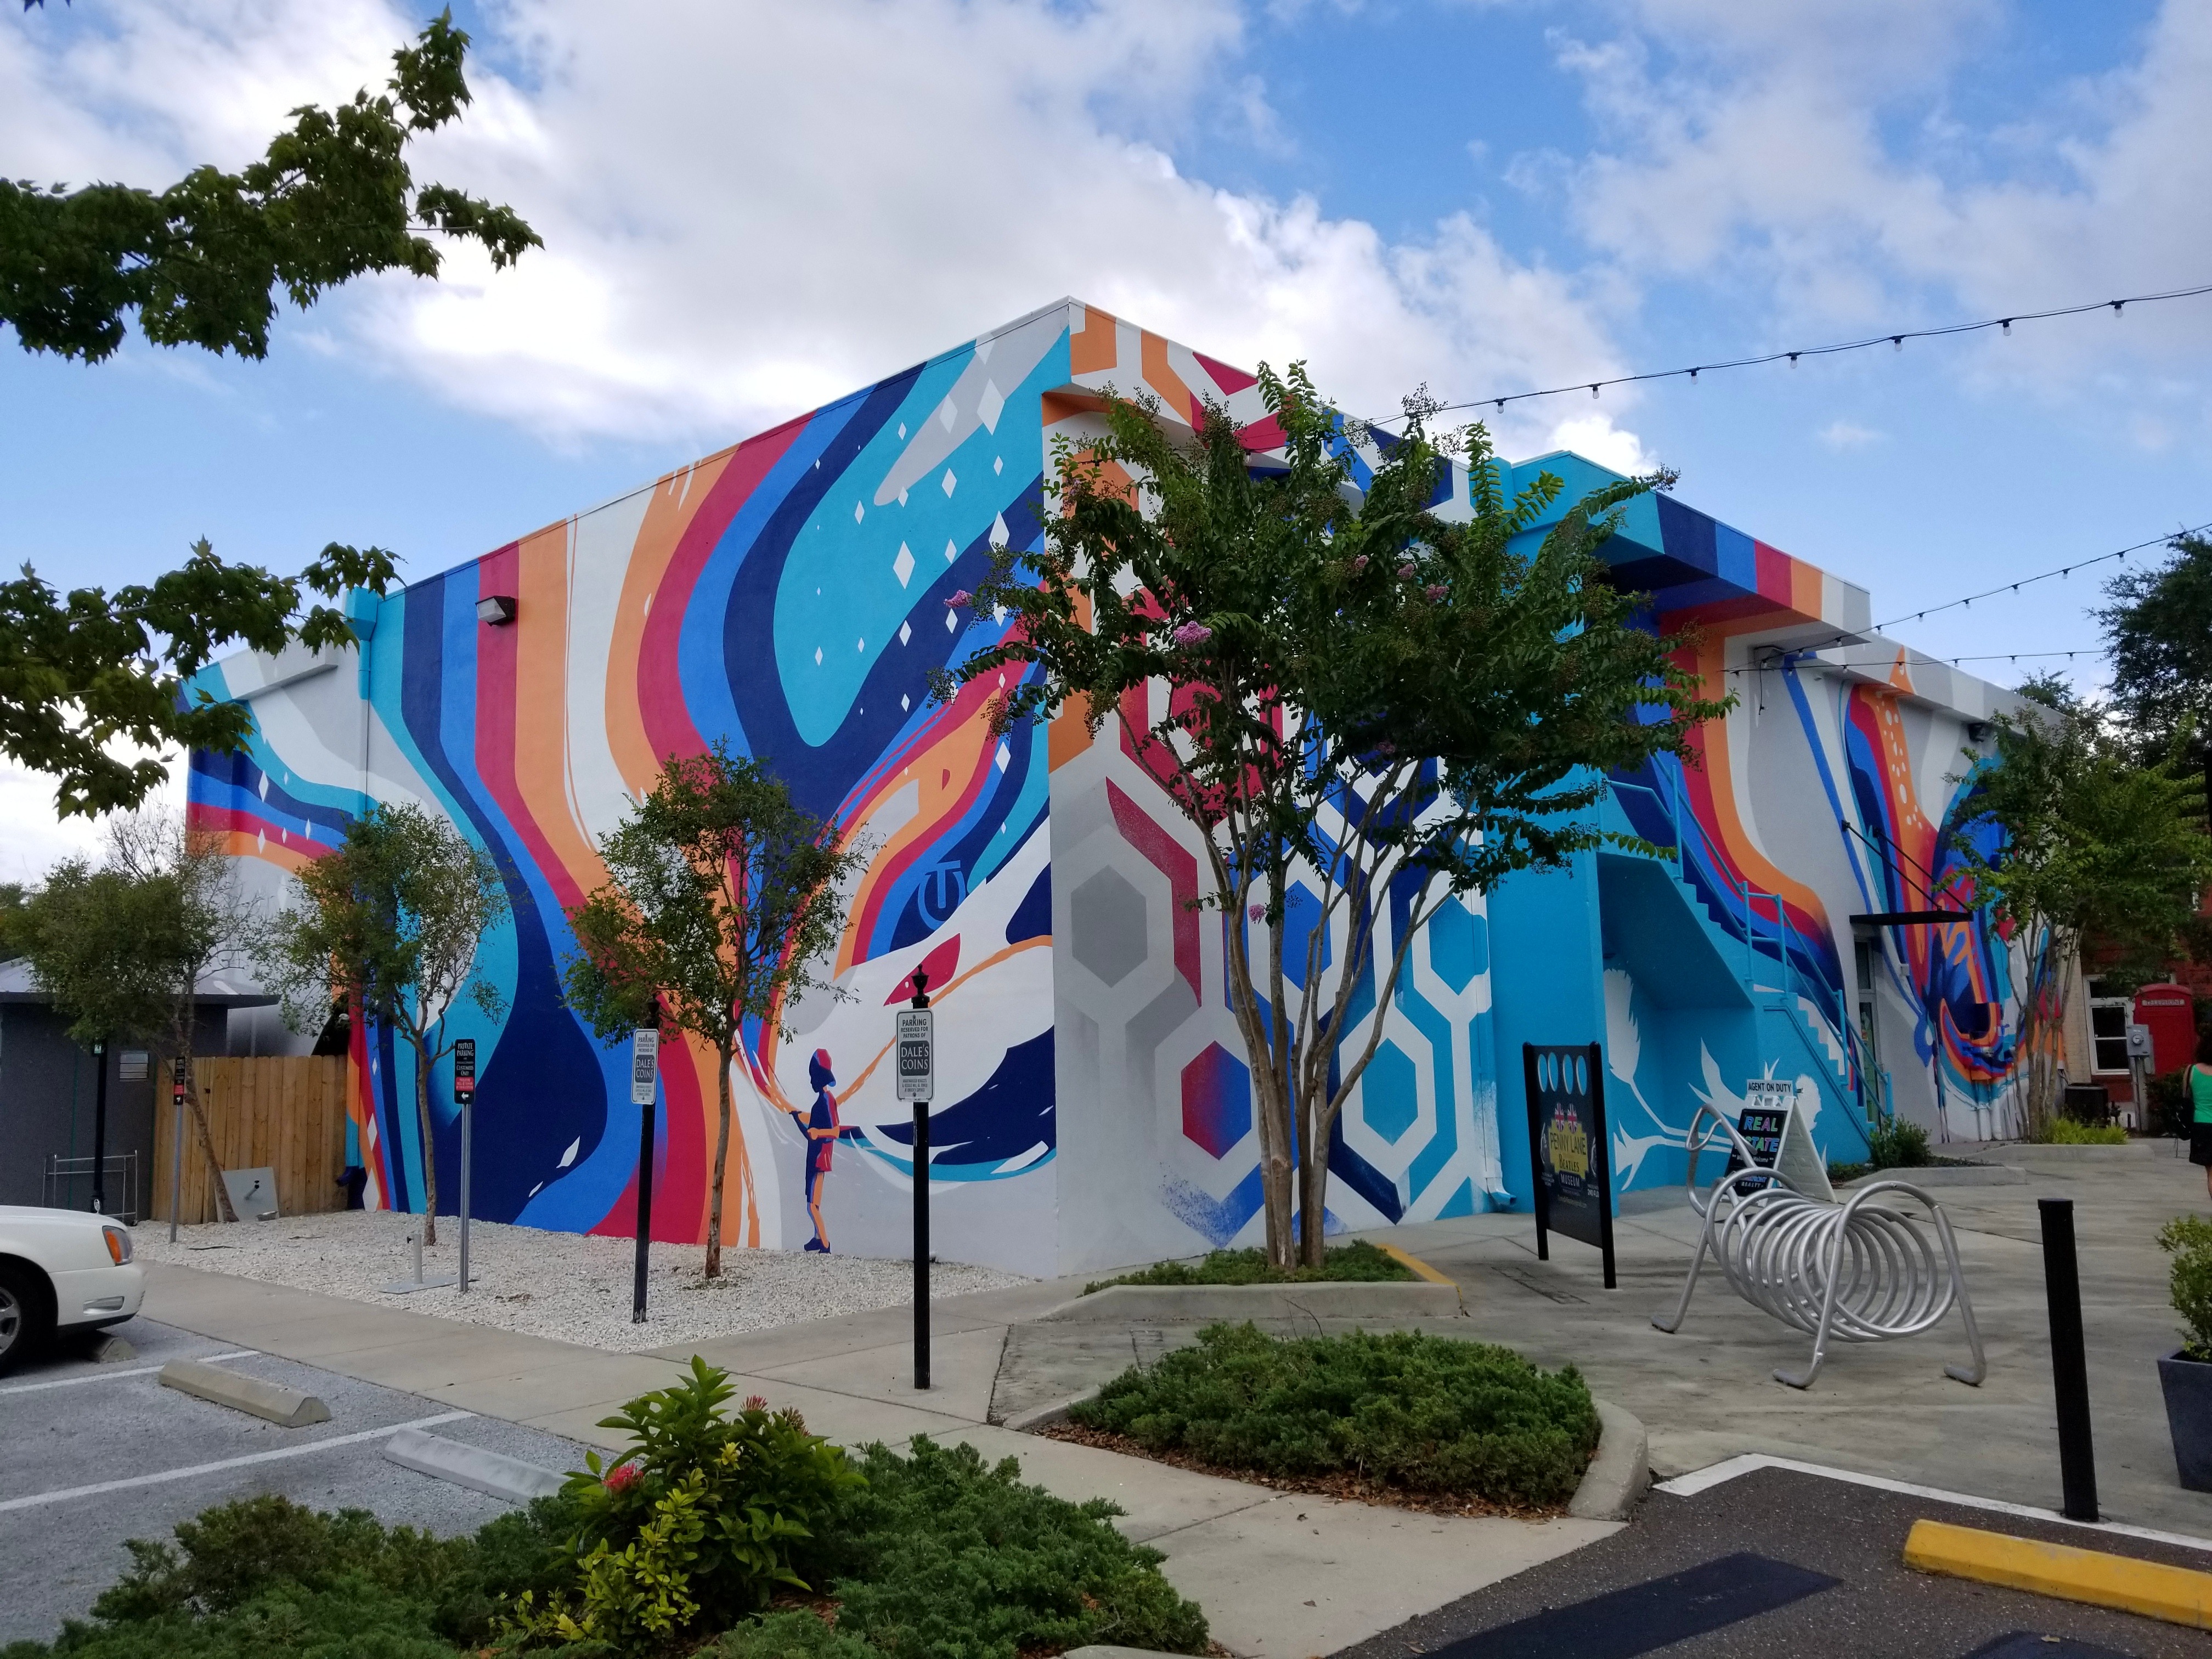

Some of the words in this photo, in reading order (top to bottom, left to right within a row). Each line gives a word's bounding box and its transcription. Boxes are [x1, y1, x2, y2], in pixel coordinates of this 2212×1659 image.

[901, 1044, 929, 1057] DALE'S
[636, 1058, 654, 1068] DALE'S
[901, 1059, 928, 1069] COINS
[636, 1069, 653, 1078] COINS
[1748, 1082, 1764, 1091] AGENT
[1767, 1083, 1774, 1091] ON
[1776, 1084, 1791, 1092] DUTY
[1743, 1116, 1778, 1132] REAL
[1550, 1132, 1568, 1152] PENNY
[1570, 1135, 1587, 1155] LANE
[1735, 1136, 1780, 1152] TATE
[1559, 1154, 1579, 1172] BEATLES
[1560, 1173, 1580, 1187] MUSEUM
